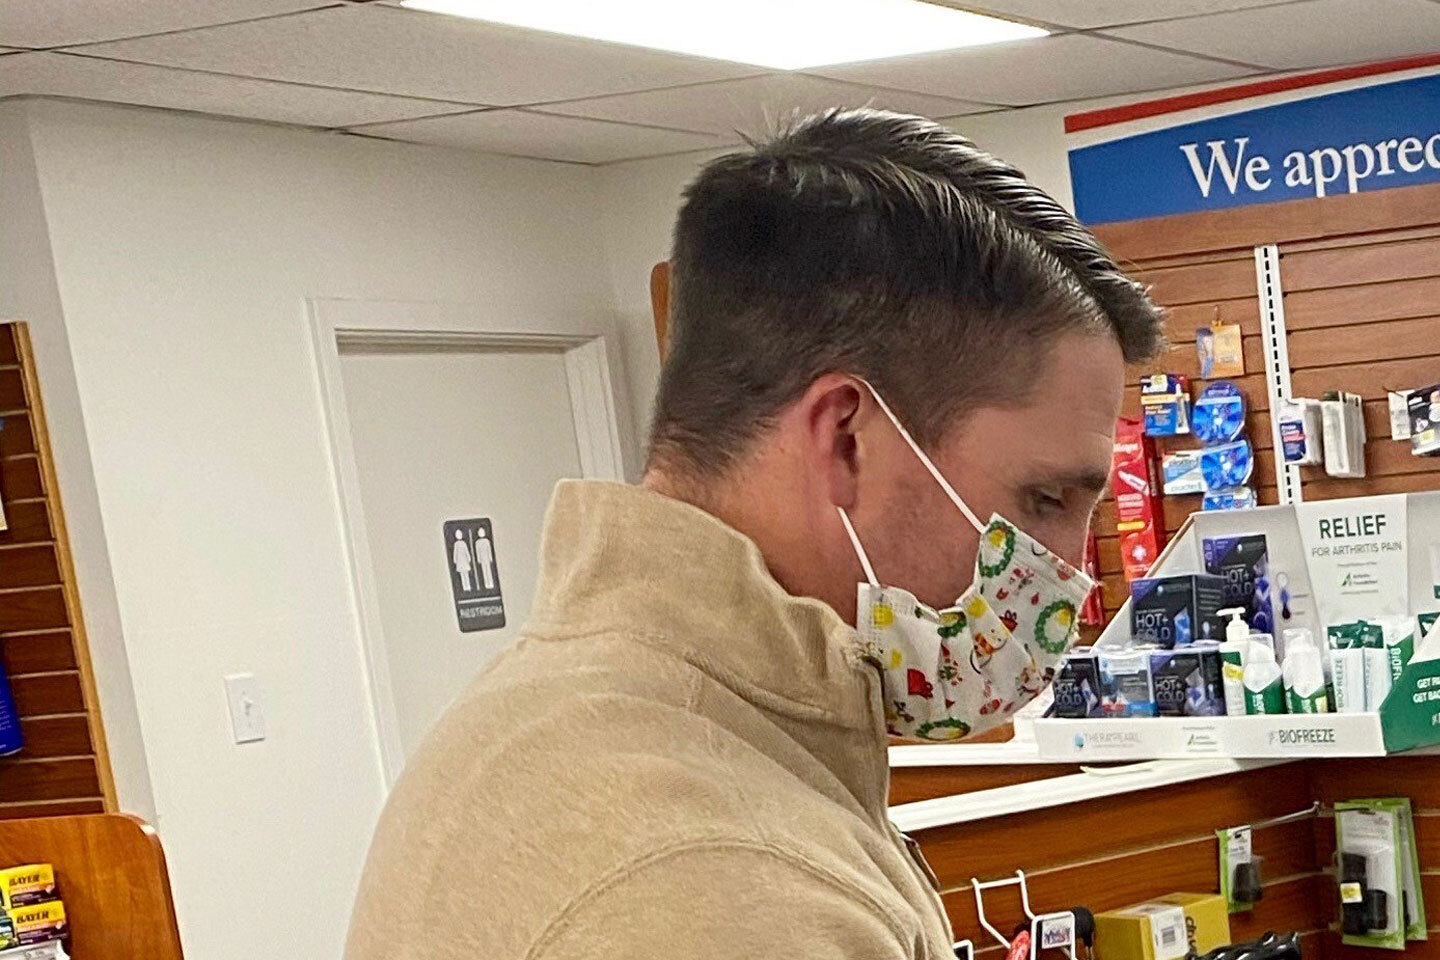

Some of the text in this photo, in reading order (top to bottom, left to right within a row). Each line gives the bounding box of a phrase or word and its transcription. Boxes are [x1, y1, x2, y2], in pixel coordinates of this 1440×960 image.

[1179, 136, 1272, 198] We
[1319, 514, 1387, 539] RELIEF
[1311, 541, 1402, 558] FOR ARTHRITIS PAIN
[1135, 612, 1169, 629] HOT+
[1417, 677, 1431, 689] GET
[1413, 691, 1427, 703] GET
[1278, 728, 1336, 744] BIOFREEZE
[16, 911, 49, 923] BAYER
